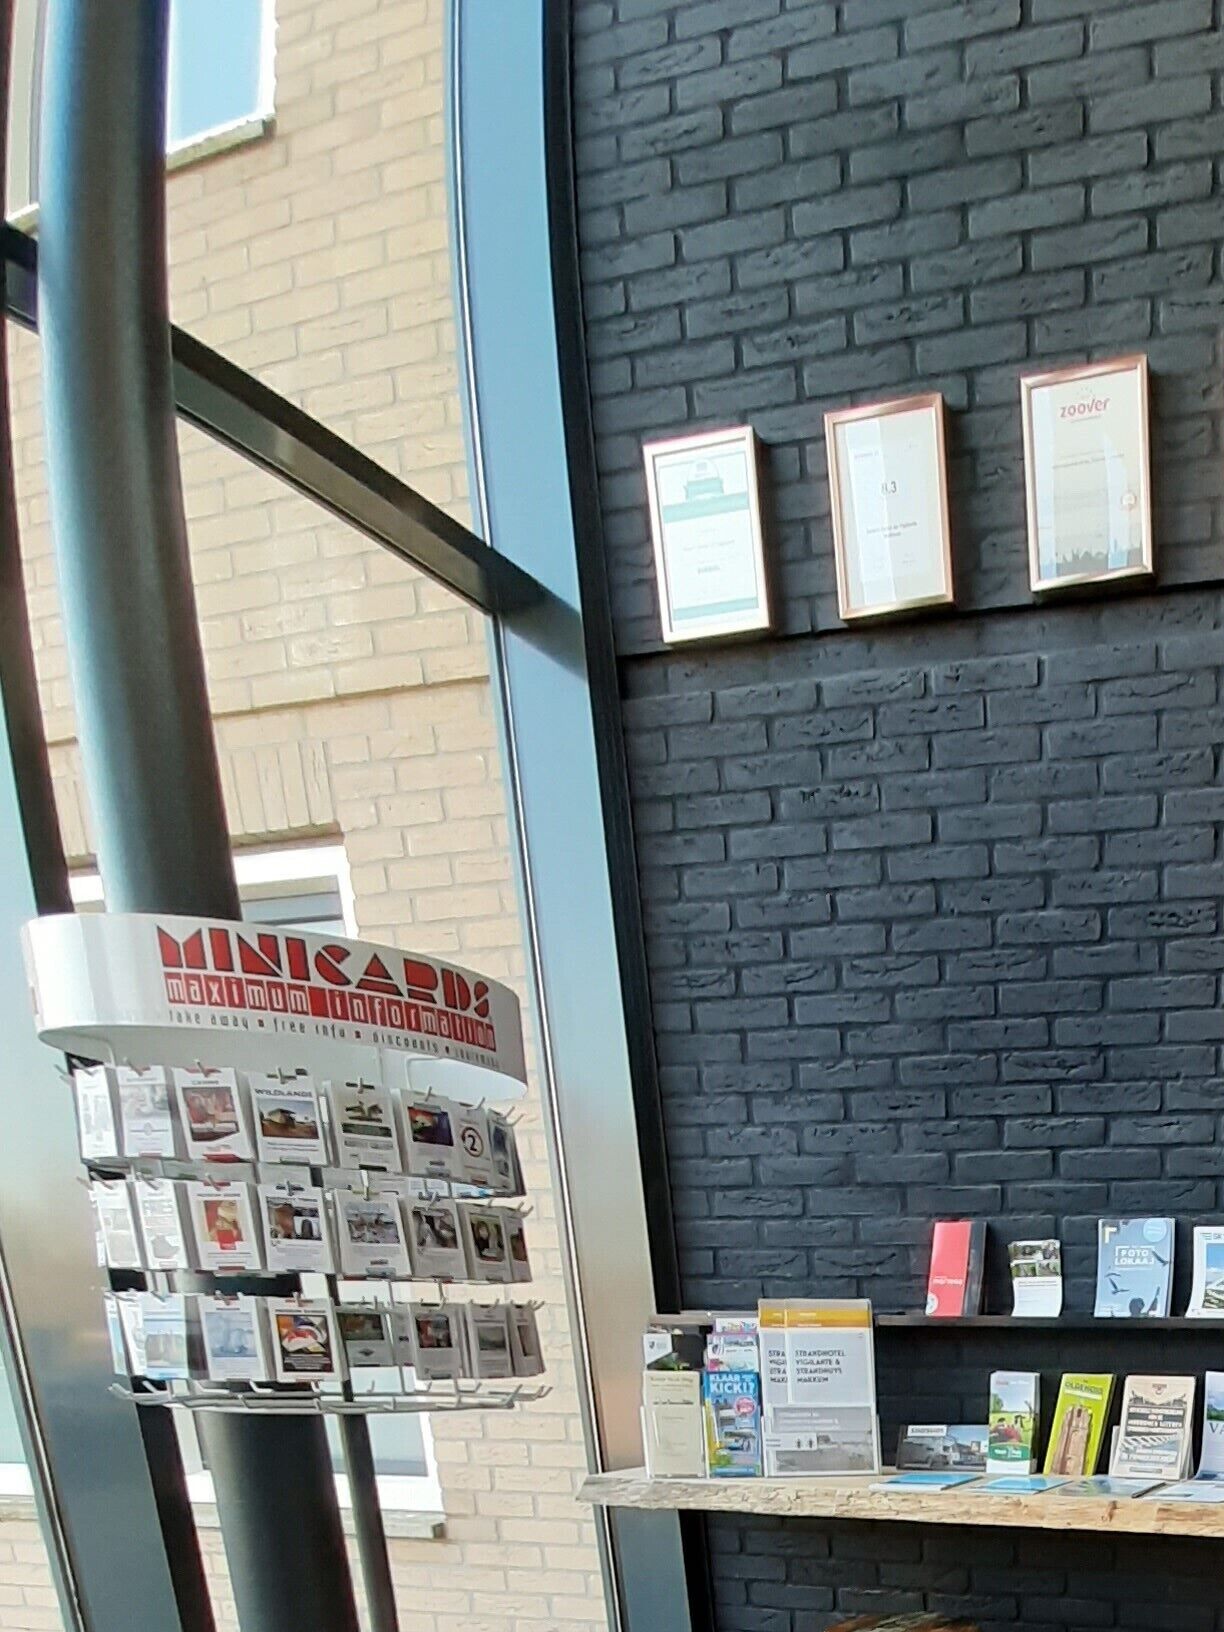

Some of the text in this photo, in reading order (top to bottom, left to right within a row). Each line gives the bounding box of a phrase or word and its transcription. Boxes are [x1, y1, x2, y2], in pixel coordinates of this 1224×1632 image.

[1060, 397, 1110, 418] zoover
[156, 925, 490, 1018] MINICARDS
[167, 976, 496, 1050] maximum information
[210, 1014, 249, 1030] away
[274, 1018, 305, 1033] free
[467, 1134, 477, 1151] 2
